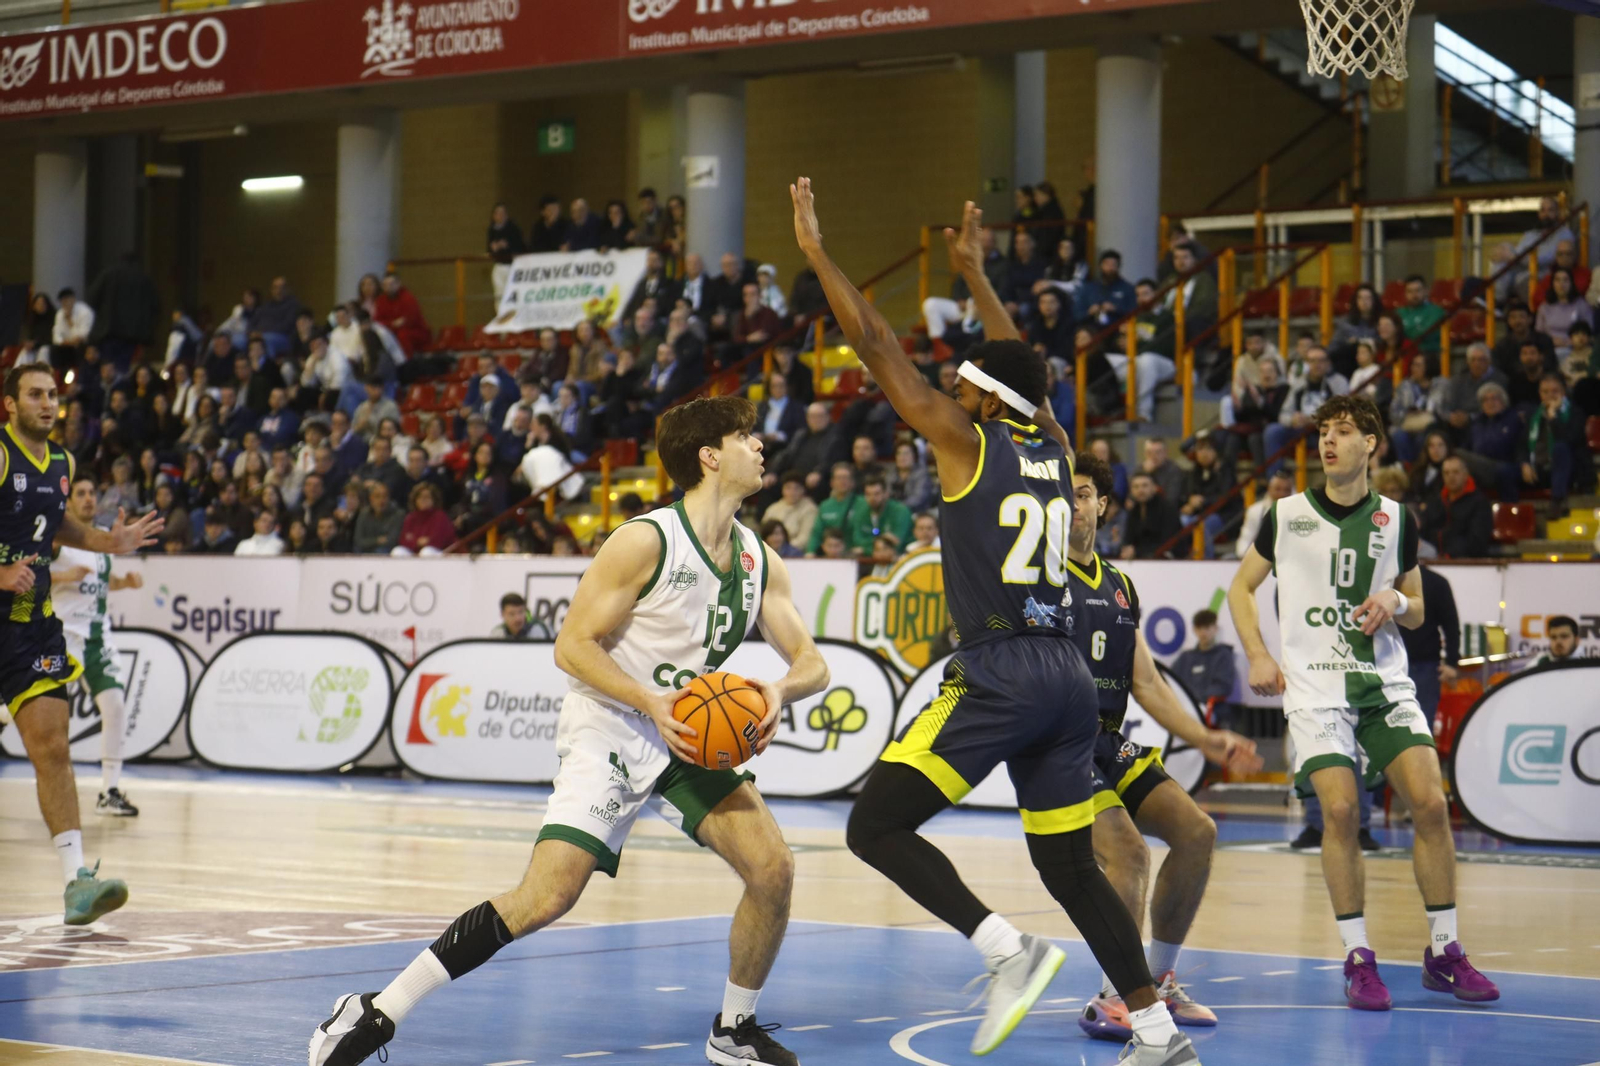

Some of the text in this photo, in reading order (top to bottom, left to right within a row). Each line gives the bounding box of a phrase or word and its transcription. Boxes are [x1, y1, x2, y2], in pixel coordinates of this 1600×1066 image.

[415, 0, 520, 30] AYUNTAMIENTO
[629, 31, 689, 50] Instituto
[691, 21, 762, 44] Municipal
[764, 20, 786, 37] de
[787, 14, 859, 37] Deportes
[860, 4, 931, 28] Córdoba
[49, 17, 227, 84] IMDECO
[415, 33, 434, 59] DE
[0, 97, 42, 114] nstituto
[46, 92, 98, 112] Municipal
[101, 90, 116, 105] de
[118, 85, 172, 104] Deportes
[548, 124, 564, 148] B
[512, 261, 615, 283] BIENVENIDO
[506, 290, 518, 303] A
[32, 514, 47, 542] 2
[999, 493, 1072, 587] 20
[1330, 548, 1357, 587] 18
[171, 594, 281, 643] Sepisur
[702, 604, 733, 652] 12
[864, 591, 951, 642] CORD
[1091, 630, 1107, 661] 6
[236, 667, 306, 695] SIERRA
[484, 690, 565, 716] Diputac
[478, 717, 558, 740] de Córd
[590, 805, 618, 827] IMDEC
